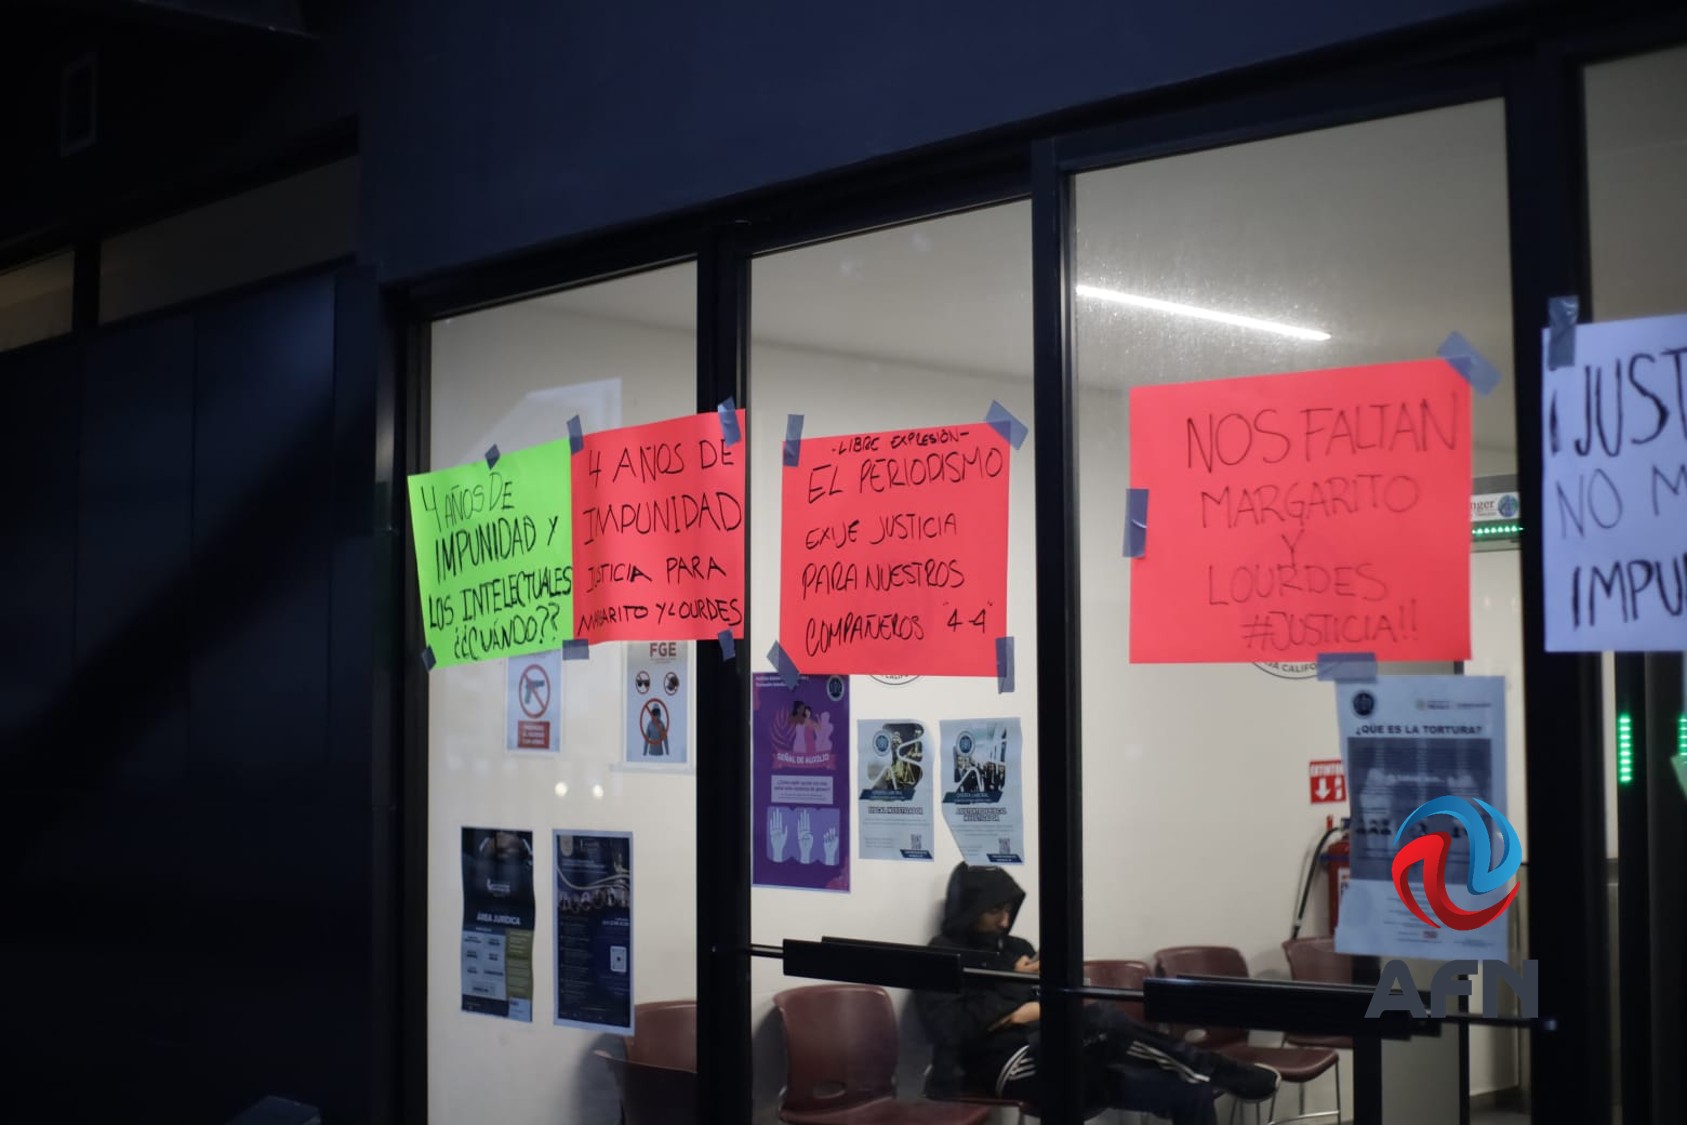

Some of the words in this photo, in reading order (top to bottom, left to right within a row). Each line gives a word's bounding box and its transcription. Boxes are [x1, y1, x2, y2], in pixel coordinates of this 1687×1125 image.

[1186, 408, 1291, 474] NOS
[1299, 391, 1459, 462] FALTAN
[588, 449, 602, 489] 4
[612, 442, 685, 483] AÑOS
[699, 438, 734, 470] DE
[808, 463, 843, 504] EL
[859, 445, 1004, 494] PERIODISMO
[420, 484, 442, 533] 4
[444, 484, 485, 529] AÑOS
[489, 471, 515, 512] DE
[583, 491, 742, 546] IMPUNIDAD
[1200, 473, 1420, 530] MARGARITO
[1555, 467, 1623, 540] NO
[435, 515, 537, 585] IMPUNIDAD
[548, 515, 559, 547] Y
[869, 512, 957, 545] JUSTICIA
[1281, 528, 1305, 569] Y
[666, 556, 727, 585] PARA
[801, 560, 858, 600] PARA
[865, 558, 966, 592] NUESTROS
[1208, 562, 1389, 606] LOURDES
[1572, 552, 1687, 632] IMPU
[429, 594, 454, 629] LOS
[459, 565, 573, 622] INTELECTUALES
[656, 601, 667, 626] Y
[668, 598, 743, 627] LOURDES
[650, 642, 677, 657] FGE
[805, 611, 925, 657] COMPAÑEROS
[1387, 725, 1402, 734] ES
[1405, 725, 1420, 734] LA
[1423, 725, 1483, 735] TORTURA?
